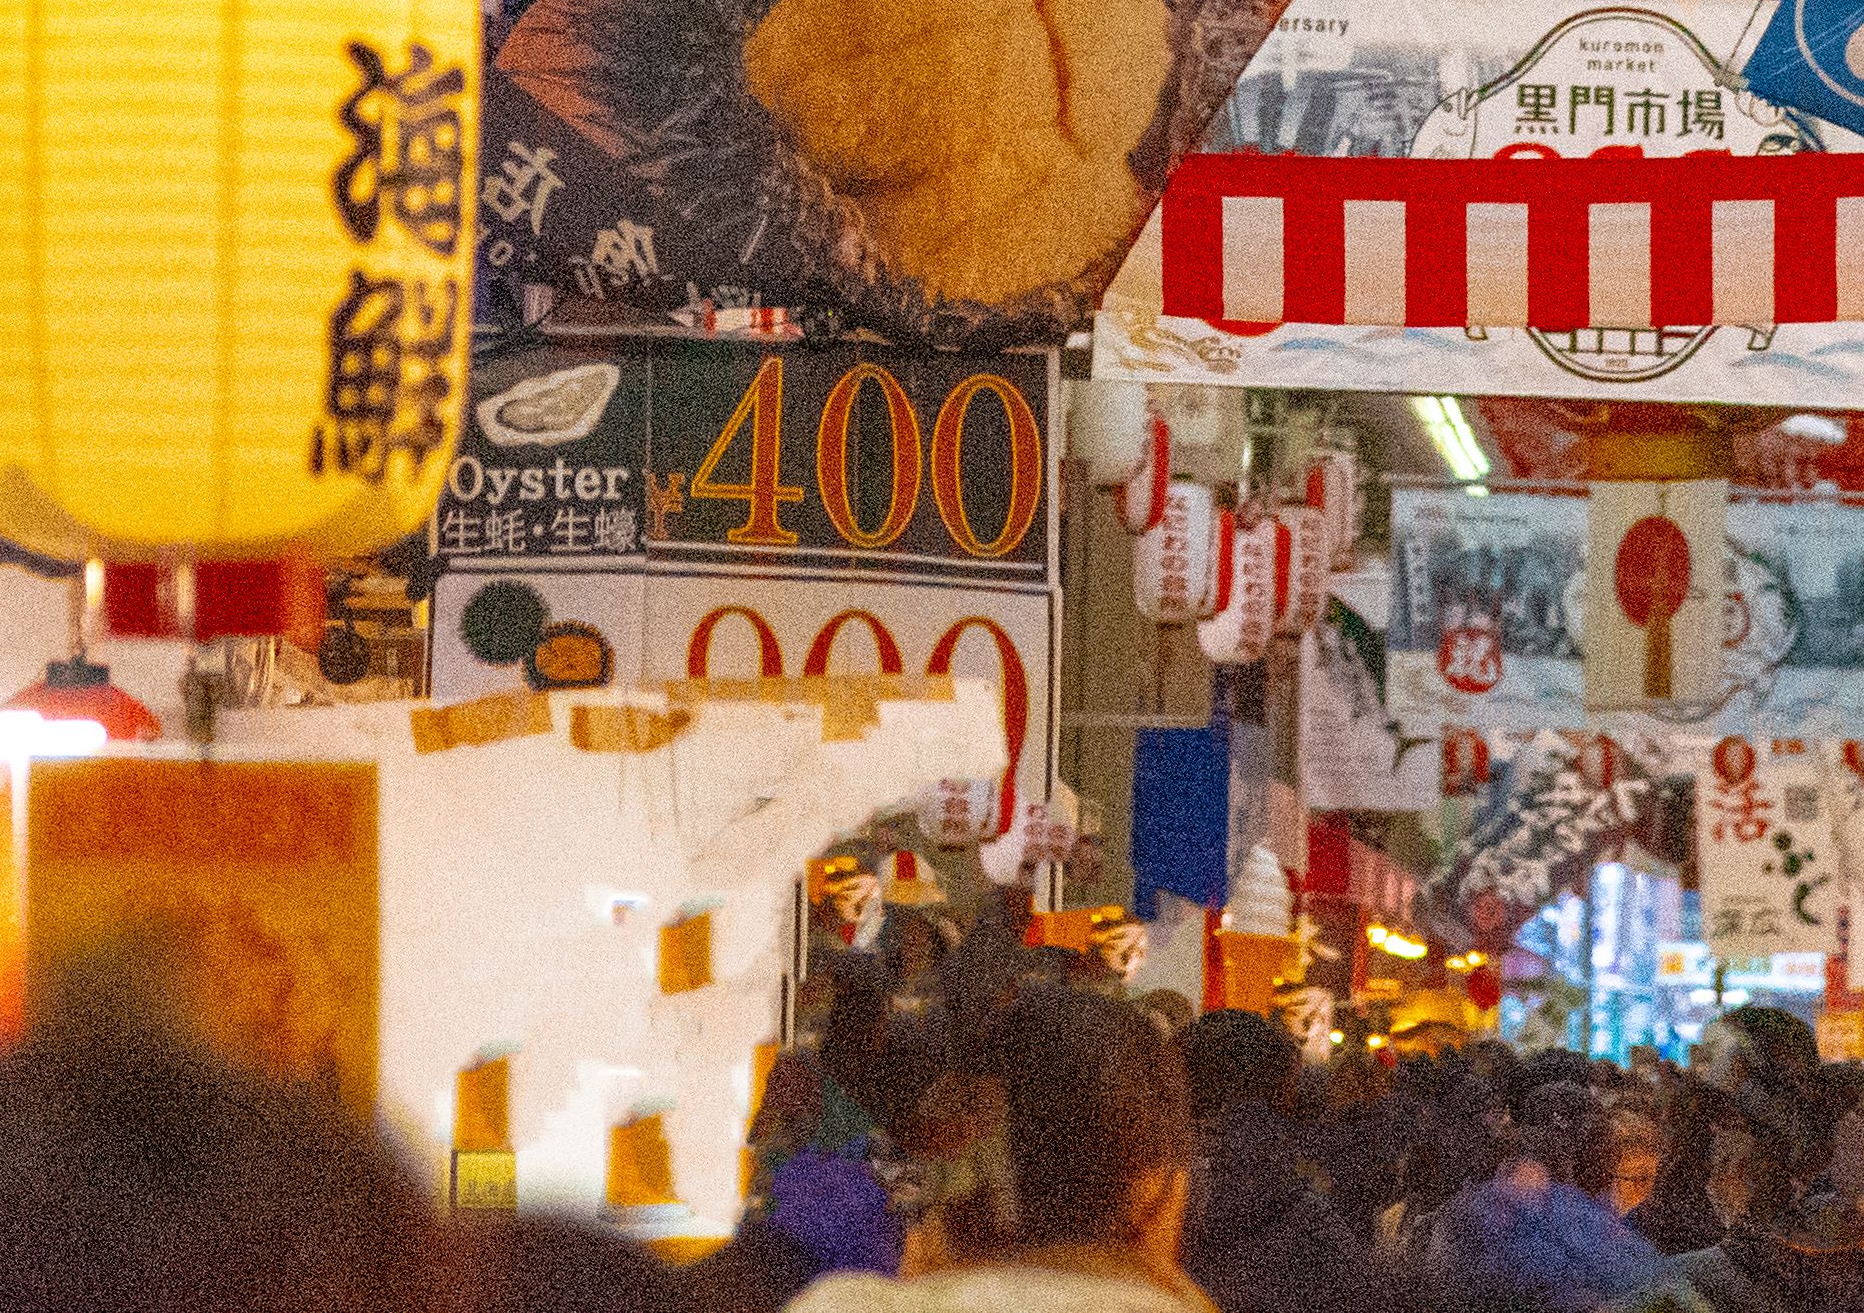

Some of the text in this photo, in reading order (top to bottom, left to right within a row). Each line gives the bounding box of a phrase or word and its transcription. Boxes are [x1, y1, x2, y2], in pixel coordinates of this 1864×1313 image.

[1578, 36, 1665, 55] kuromon
[1586, 56, 1657, 73] market
[1513, 84, 1726, 140] 黒門市場
[448, 454, 630, 514] Oyster
[647, 354, 1042, 559] ¥400
